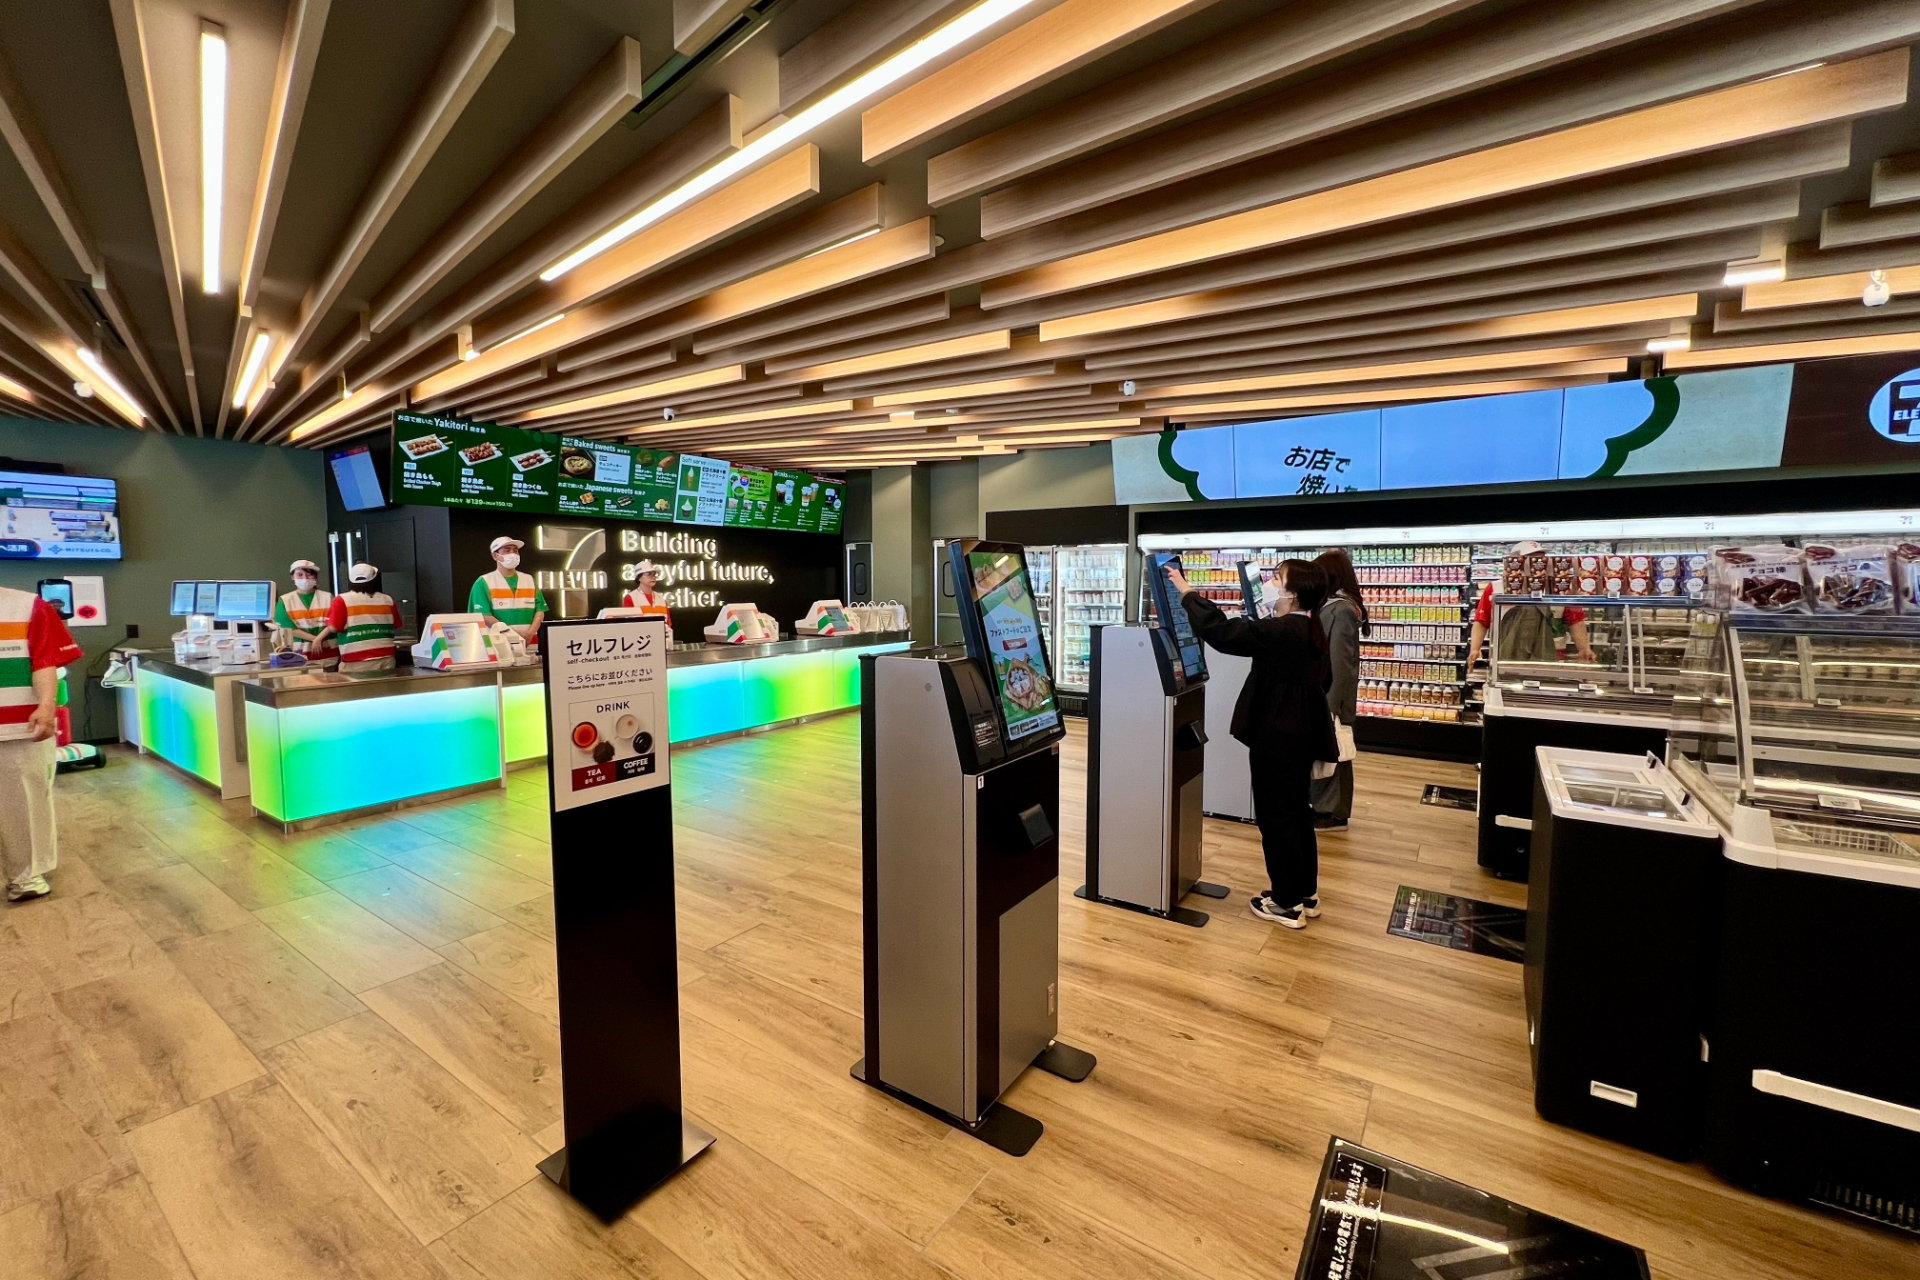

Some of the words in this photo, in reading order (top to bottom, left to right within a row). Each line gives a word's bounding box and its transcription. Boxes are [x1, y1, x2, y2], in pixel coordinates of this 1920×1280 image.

[434, 417, 468, 431] Yakitori
[574, 439, 594, 449] Baked
[594, 443, 616, 452] sweets
[1284, 445, 1351, 473] お店で
[584, 483, 613, 493] Japanese
[613, 487, 633, 495] sweets
[621, 529, 716, 559] Building
[621, 564, 636, 580] a
[645, 559, 704, 586] oyful
[711, 560, 775, 585] future,
[566, 634, 652, 656] セルフレジ
[567, 656, 610, 665] self-checkout
[567, 668, 653, 684] こちらにお並びください
[596, 701, 630, 714] DRINK
[623, 758, 649, 769] COFFEE
[587, 768, 602, 776] TEA
[1328, 1161, 1364, 1280] 発電しその電気でが発光します
